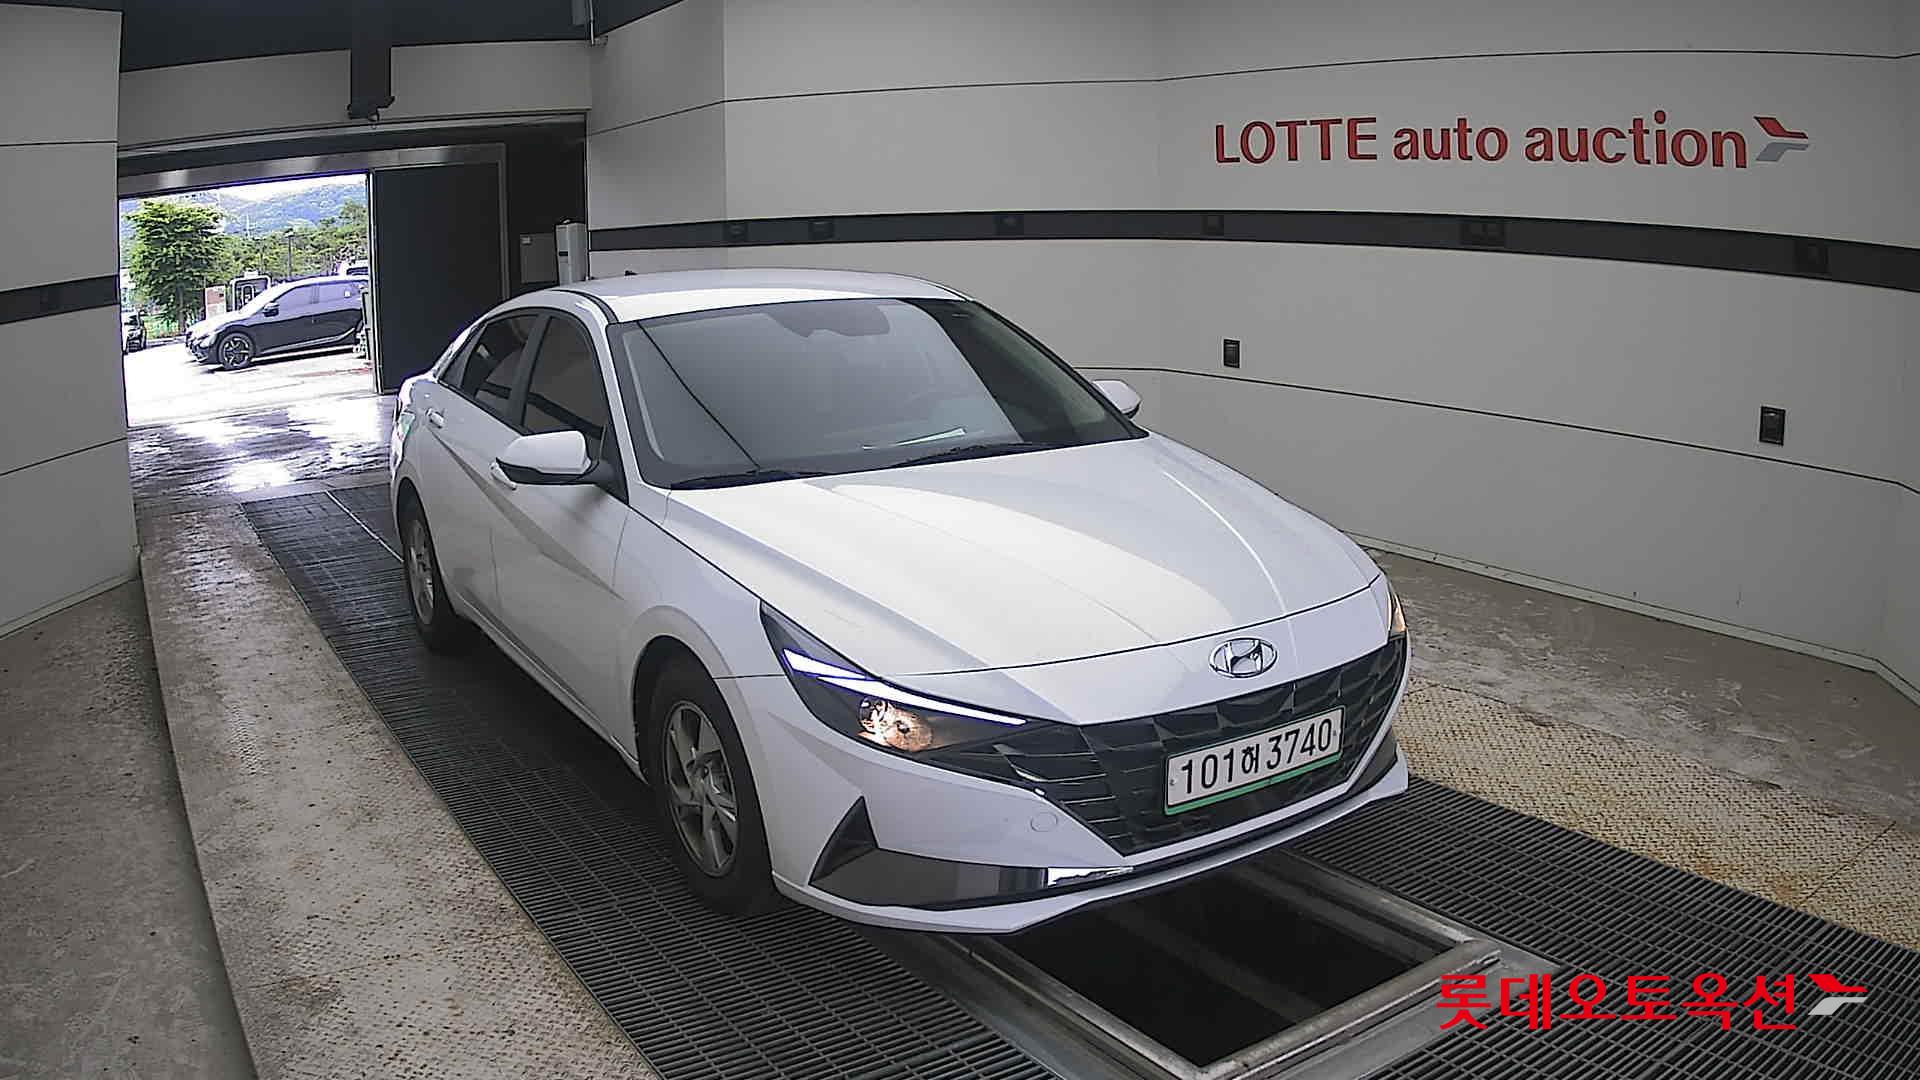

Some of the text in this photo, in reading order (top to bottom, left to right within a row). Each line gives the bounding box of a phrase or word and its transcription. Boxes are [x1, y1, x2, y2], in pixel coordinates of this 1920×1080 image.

[1215, 110, 1747, 168] LOTTE auto auction
